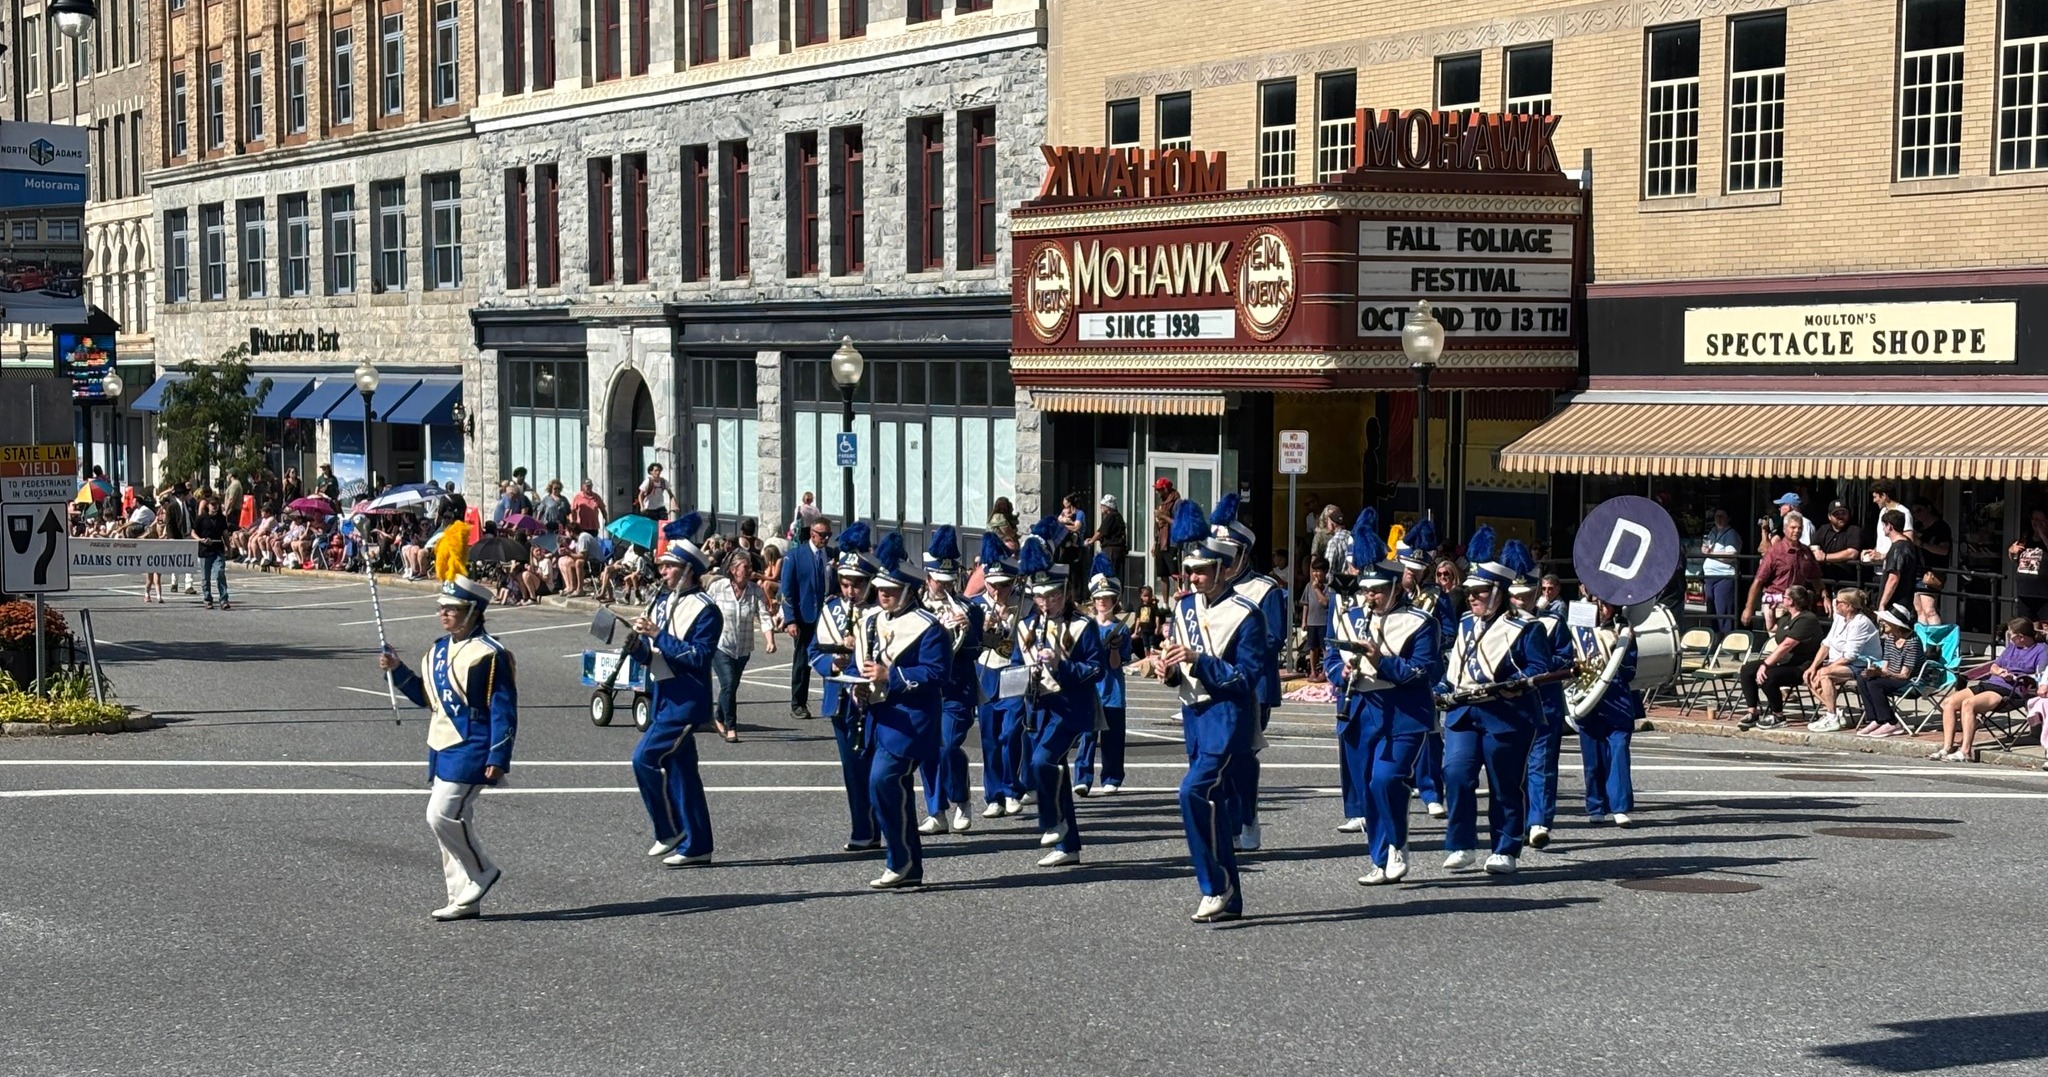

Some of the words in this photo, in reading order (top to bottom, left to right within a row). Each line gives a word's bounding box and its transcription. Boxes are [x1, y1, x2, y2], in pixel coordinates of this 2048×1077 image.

[1357, 108, 1562, 172] MOHAWK
[1, 145, 28, 155] NORTH
[56, 149, 82, 158] ADAMS
[25, 178, 80, 191] Motorama
[1386, 226, 1441, 251] FALL
[1457, 227, 1552, 253] FOLIAGE
[1073, 239, 1231, 306] MOHAWK
[1411, 267, 1521, 292] FESTIVAL
[1105, 315, 1156, 338] SINCE
[1166, 313, 1200, 336] 1938
[1361, 307, 1411, 331] OCT
[1431, 307, 1464, 331] ND
[1471, 307, 1501, 331] TO
[1804, 312, 1876, 326] MOULTON'S
[317, 326, 341, 352] Bank
[1706, 331, 1854, 357] SPECTACLE
[1872, 328, 1986, 355] SHOPPE
[1290, 433, 1298, 441] NO
[4, 447, 40, 460] STATE
[47, 446, 71, 459] LAW
[1282, 442, 1305, 450] PARKING
[20, 461, 60, 475] YIELD
[22, 479, 71, 488] PEDESTRIANS
[24, 489, 68, 498] CROSSWALK
[1598, 517, 1652, 580] D
[73, 554, 112, 566] ADAMS
[117, 554, 142, 567] CITY
[147, 553, 195, 567] COUNCIL
